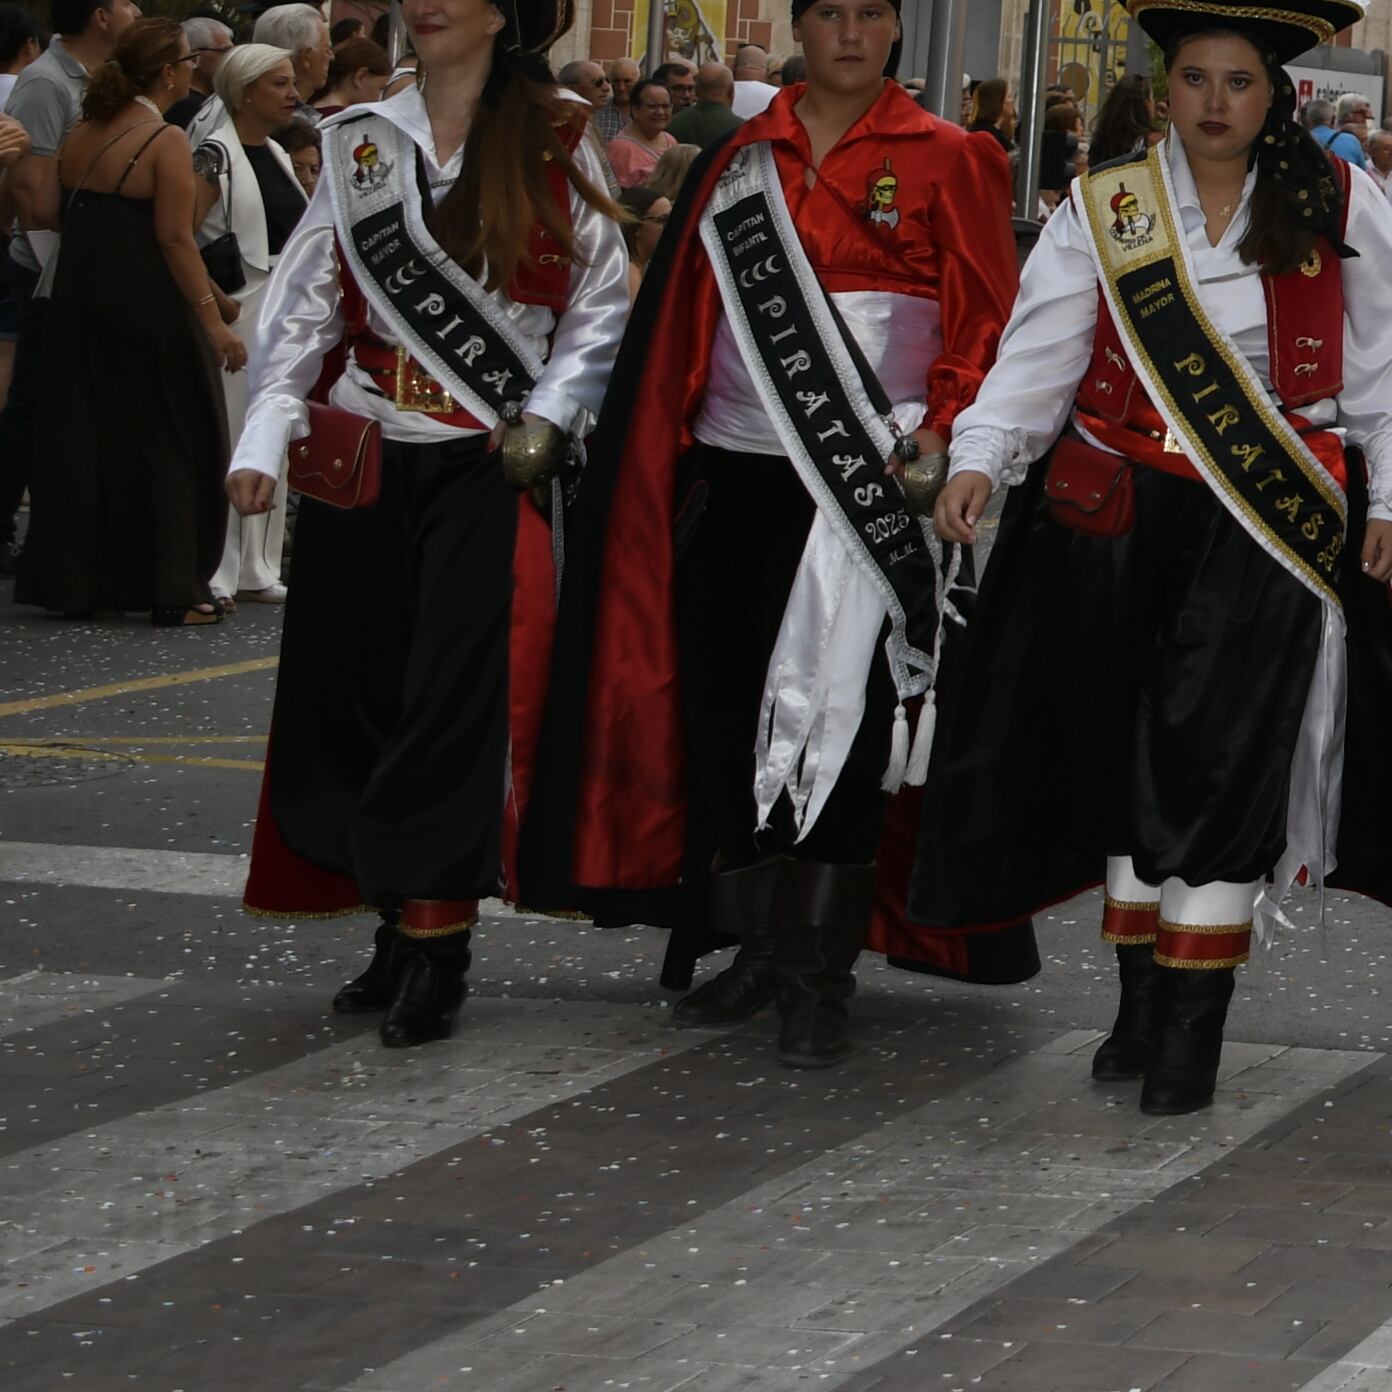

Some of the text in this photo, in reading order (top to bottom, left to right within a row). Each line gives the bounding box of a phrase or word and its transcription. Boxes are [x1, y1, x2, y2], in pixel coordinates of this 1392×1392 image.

[361, 222, 400, 251] CAPITAN
[727, 212, 765, 242] CAPITAN
[371, 239, 403, 265] MAYOR
[732, 231, 769, 257] INFANTIL
[1122, 236, 1154, 253] VILLENA
[1132, 278, 1173, 305] MADRINA
[1139, 293, 1176, 319] MAYOR
[758, 294, 886, 508] PIRATAS
[1173, 352, 1326, 541] PIRATAS
[865, 510, 911, 545] 2025
